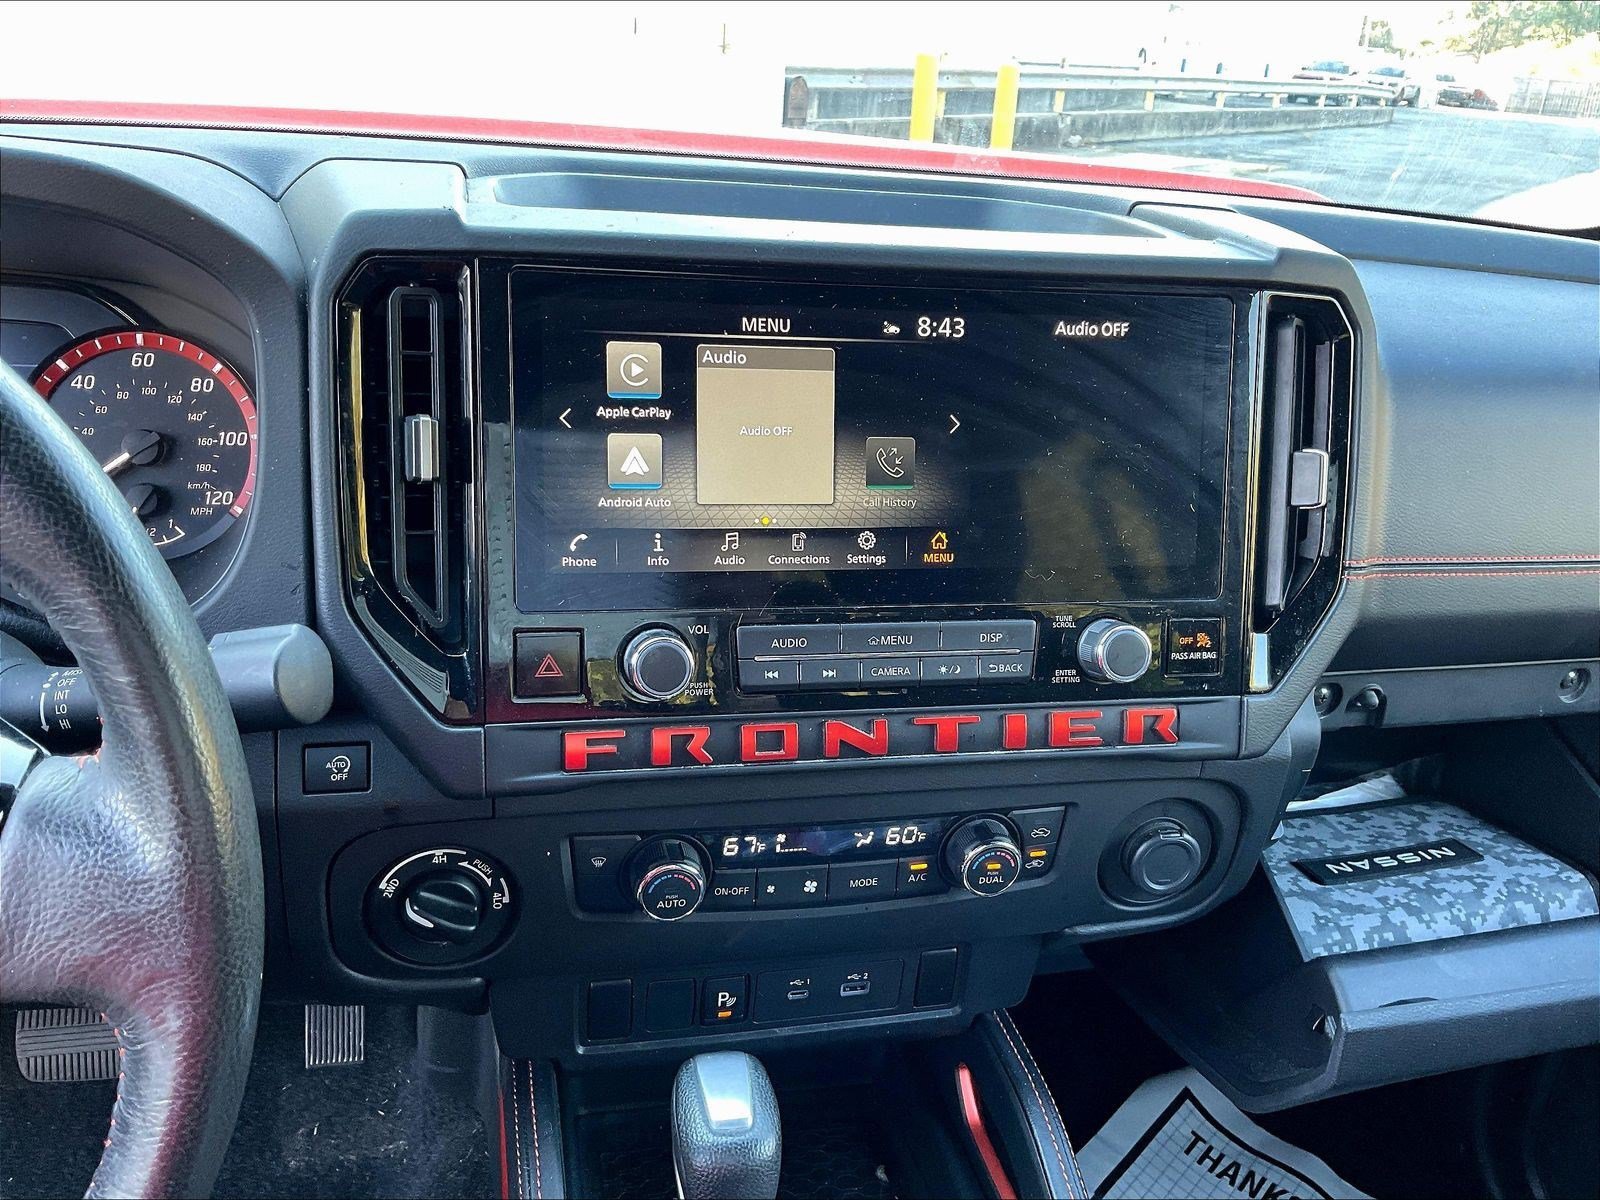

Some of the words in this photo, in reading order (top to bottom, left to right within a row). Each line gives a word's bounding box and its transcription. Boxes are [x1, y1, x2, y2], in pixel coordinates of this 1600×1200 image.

[742, 318, 790, 332] MENU
[917, 317, 965, 338] 8:43
[1054, 320, 1098, 336] Audio
[1101, 322, 1130, 336] OFF
[131, 352, 154, 368] 60
[702, 350, 747, 364] Audio
[71, 375, 95, 389] 40
[190, 378, 214, 393] 80
[116, 391, 129, 400] 80
[141, 387, 156, 395] 100
[167, 395, 182, 404] 120
[95, 406, 107, 414] 60
[596, 406, 630, 419] Apple
[632, 407, 672, 420] CarPlay
[187, 413, 202, 422] 140
[81, 427, 94, 436] 40
[740, 426, 770, 436] Audio
[773, 426, 793, 436] OFF
[197, 438, 212, 446] 160
[218, 432, 247, 446] 100
[196, 464, 211, 472] 180
[188, 481, 210, 490] km/h
[204, 491, 233, 506] 120
[598, 497, 642, 507] Android
[645, 498, 671, 507] Auto
[863, 498, 881, 508] Call
[883, 498, 917, 509] History
[190, 508, 213, 516] MPH
[168, 519, 173, 528] 1
[562, 556, 597, 567] Phone
[647, 556, 670, 566] Info
[714, 556, 745, 565] Audio
[768, 555, 830, 565] Connections
[847, 554, 886, 566] Settings
[924, 553, 954, 563] MENU
[688, 625, 709, 634] VOL
[771, 638, 808, 648] AUDIO
[880, 636, 913, 646] MENU
[980, 634, 1003, 643] DISP
[1171, 652, 1188, 660] PASS
[871, 667, 911, 676] CAMERA
[999, 664, 1022, 672] BACK
[57, 678, 77, 687] OFF
[54, 690, 70, 700] INT
[55, 704, 67, 714] LO
[59, 719, 71, 729] HI
[563, 708, 1178, 771] FRONTIER
[1325, 846, 1456, 875] NISSAN
[473, 858, 493, 876] PUSH
[850, 878, 878, 888] MODE
[908, 873, 928, 883] A/C
[979, 876, 1004, 885] DUAL
[383, 878, 400, 898] 2WD
[493, 892, 502, 910] 4LO
[656, 899, 686, 909] AUTO
[1183, 1130, 1300, 1200] THANK
